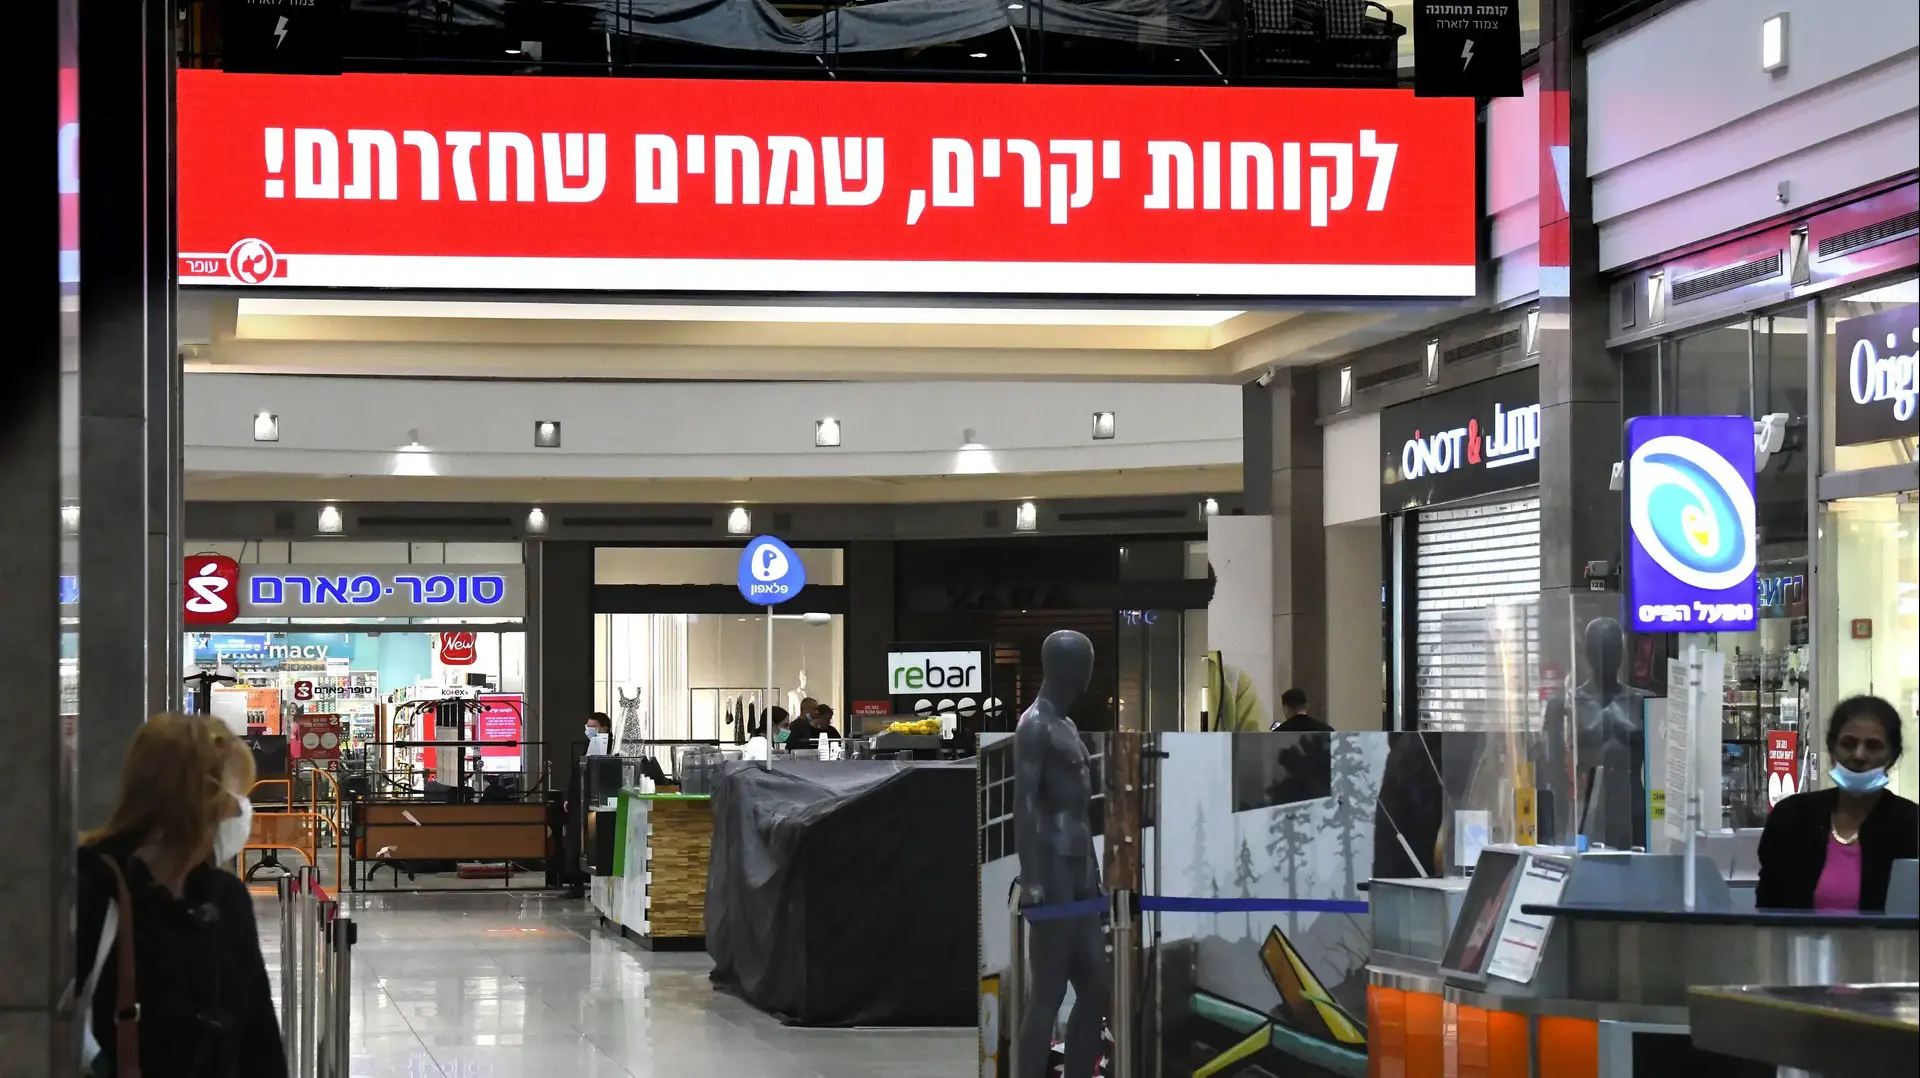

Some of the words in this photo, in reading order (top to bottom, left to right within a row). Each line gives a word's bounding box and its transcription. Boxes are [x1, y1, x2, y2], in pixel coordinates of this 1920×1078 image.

[1426, 5, 1473, 15] תחתונה
[1477, 6, 1509, 17] קומה
[1437, 18, 1469, 29] לזארה
[1473, 20, 1499, 29] צמוד
[265, 128, 607, 204] שחזרתם!
[636, 133, 885, 206] שמחים
[906, 138, 1121, 226] יקרים,
[1144, 130, 1399, 227] לקוחות
[185, 260, 219, 274] עופר
[1467, 419, 1482, 465] &
[750, 582, 789, 596] פלאפון
[1638, 604, 1691, 623] הפיס
[1693, 600, 1754, 624] מפעל
[442, 632, 475, 653] New
[894, 658, 977, 689] rebar
[441, 688, 466, 696] kotex
